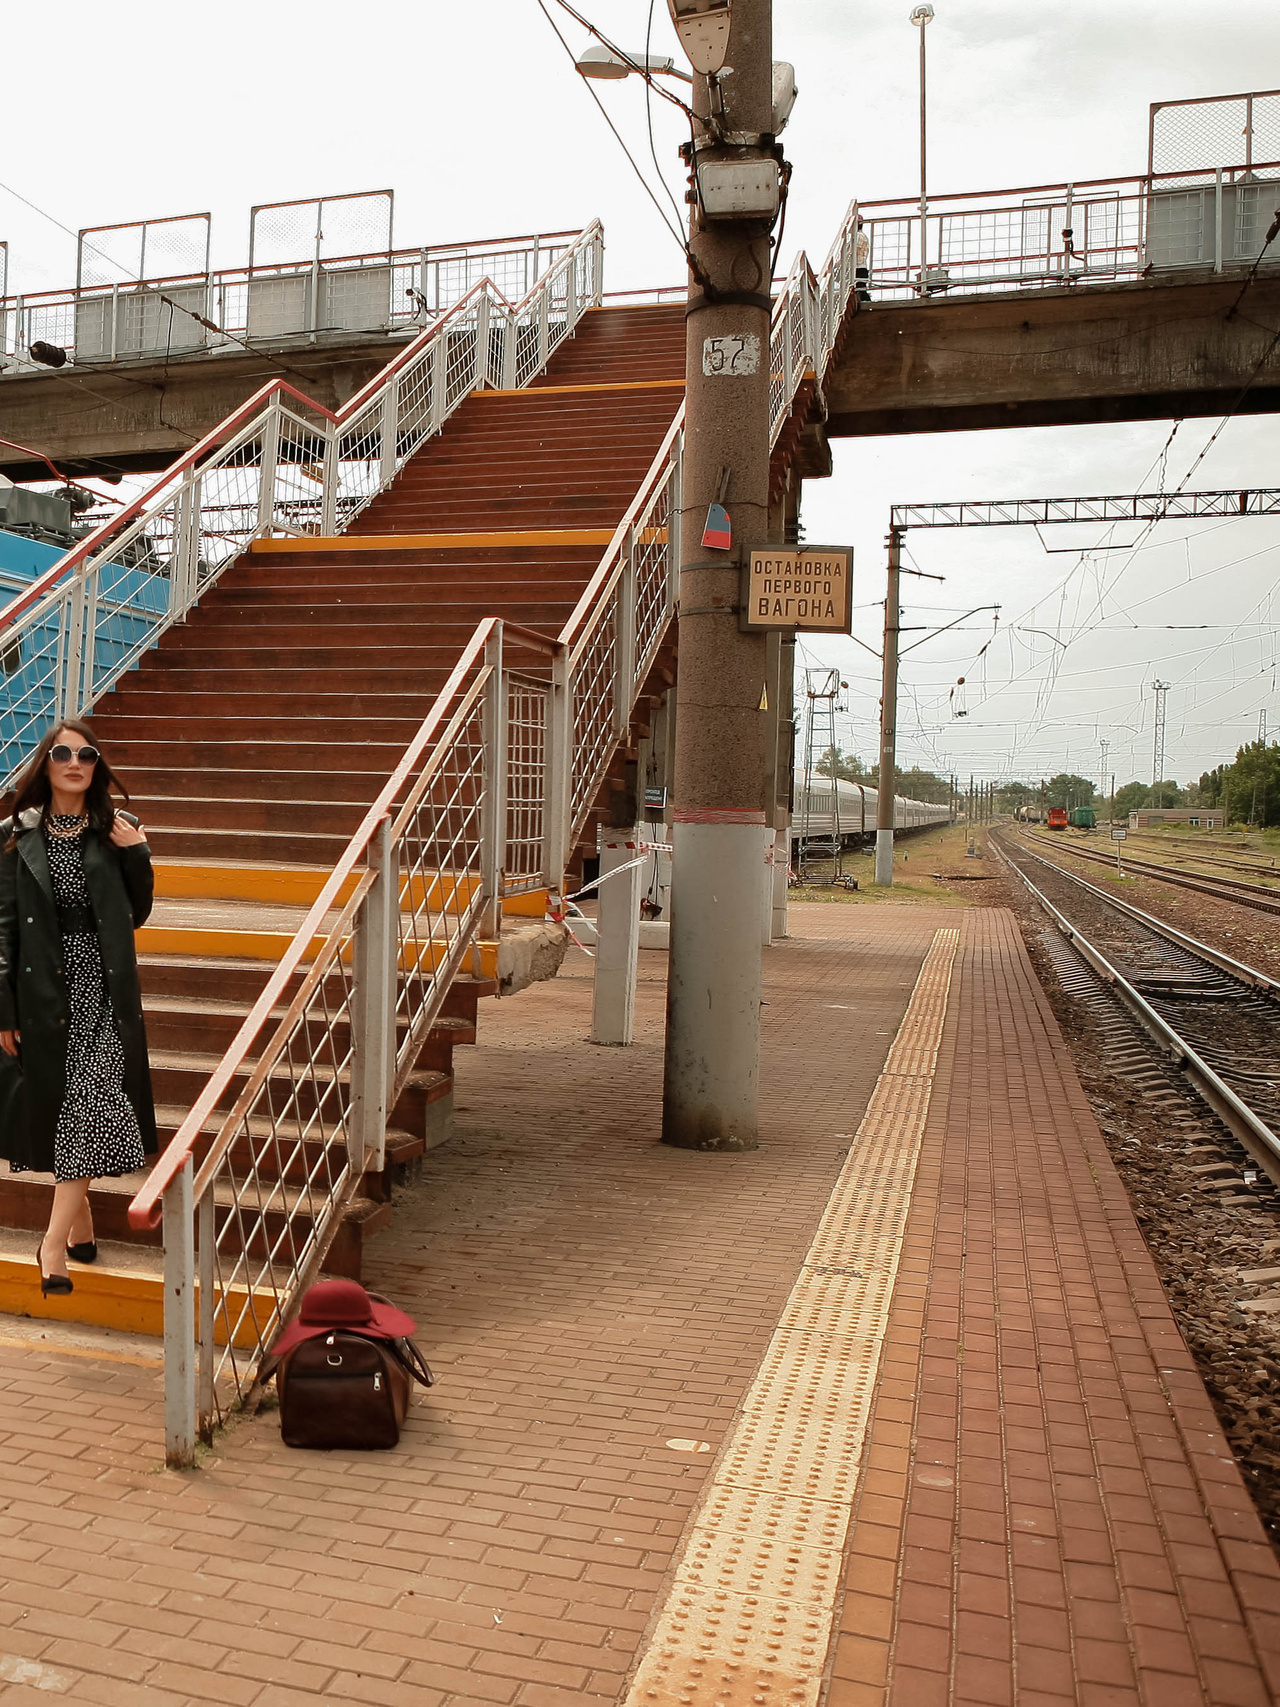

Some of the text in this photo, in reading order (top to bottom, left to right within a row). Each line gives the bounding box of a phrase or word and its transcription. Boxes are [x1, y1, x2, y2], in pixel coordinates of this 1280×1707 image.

[711, 338, 745, 372] 57
[754, 560, 842, 577] ОСТАНОВКА
[763, 579, 831, 595] ПЕРВОГО
[758, 597, 835, 618] ВАГОНА
